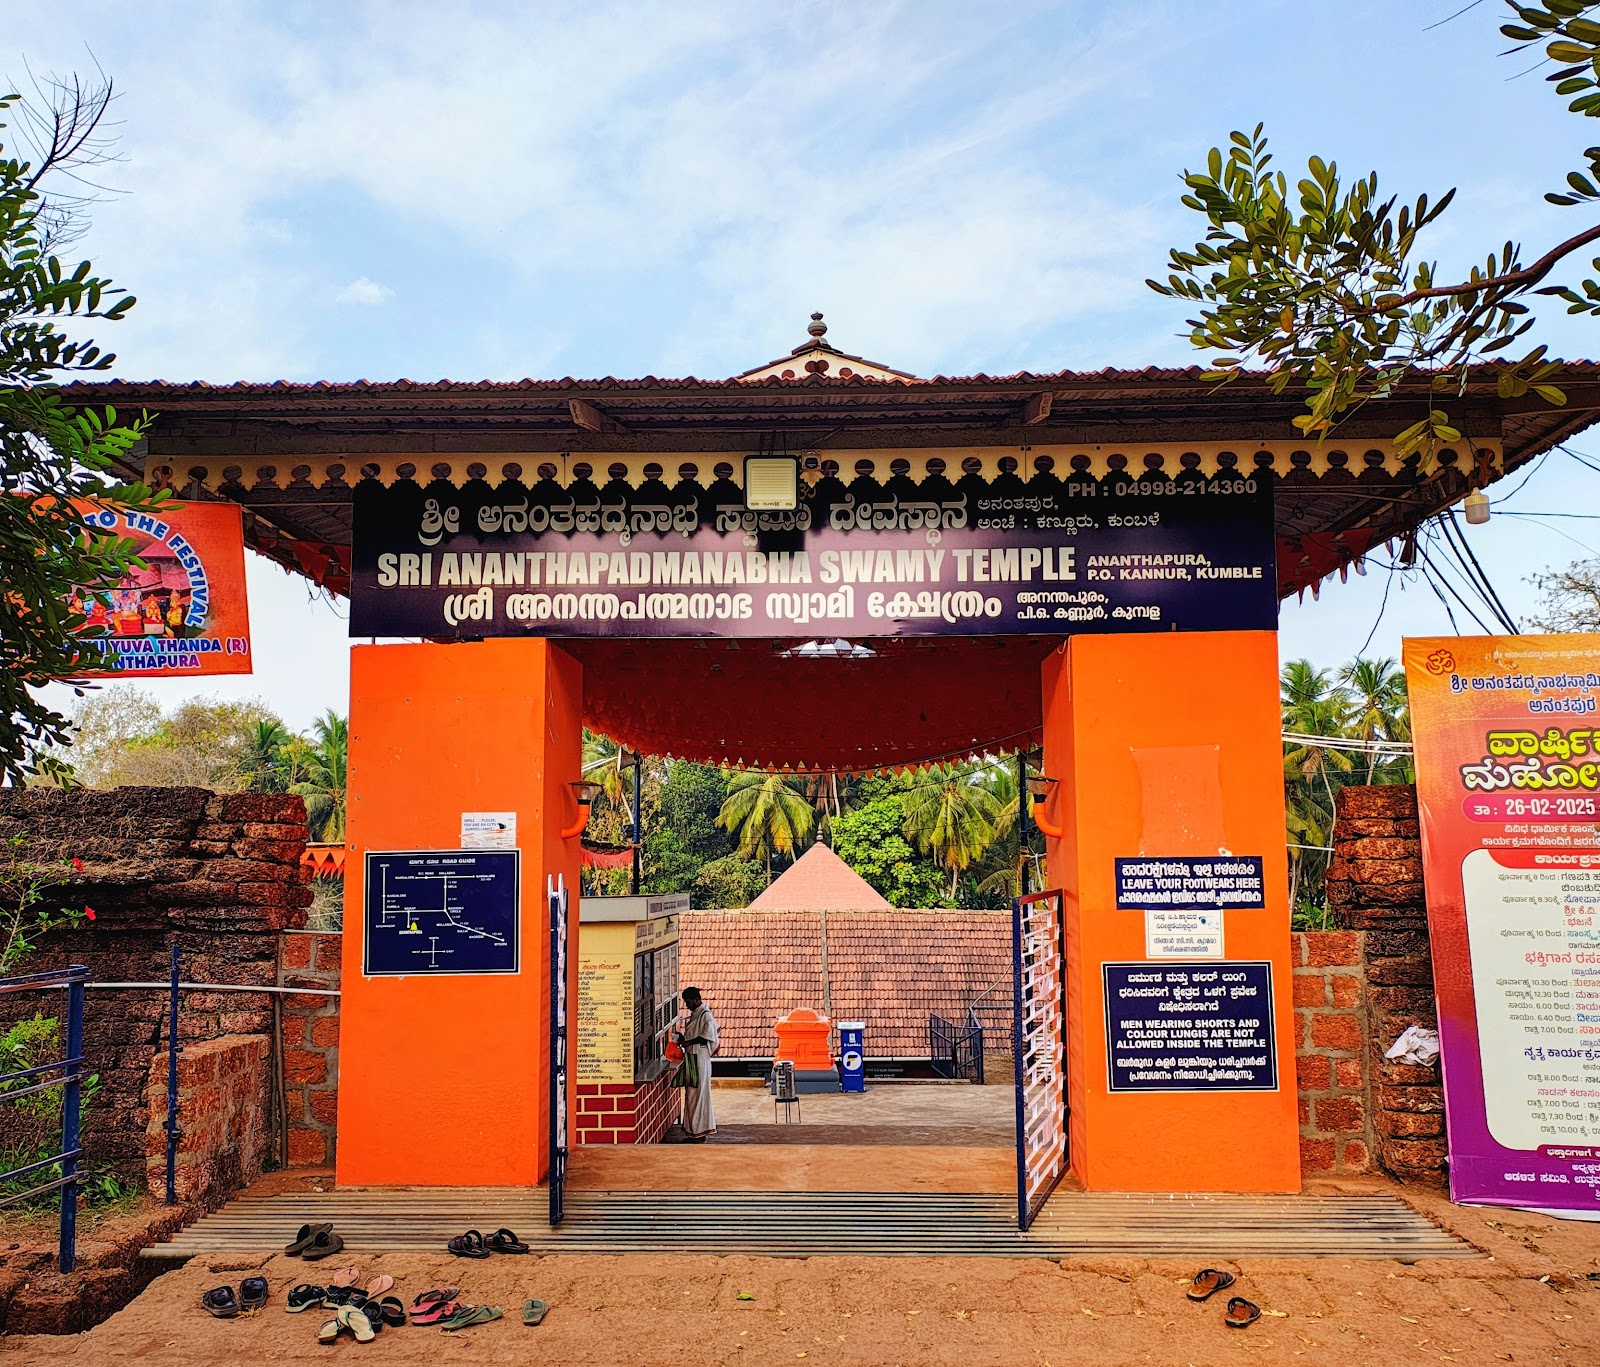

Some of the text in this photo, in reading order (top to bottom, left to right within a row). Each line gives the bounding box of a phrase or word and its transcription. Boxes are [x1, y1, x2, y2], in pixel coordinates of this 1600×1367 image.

[1068, 483, 1097, 497] PH
[1115, 479, 1257, 497] 04998-214360
[977, 496, 1058, 512] ಅನಂತಪುರ,
[418, 498, 460, 546] ಶ್ರೀ
[478, 495, 698, 547] ಅನಂತಪದ್ಮನಾಭ
[829, 492, 968, 548] ದೇವಸ್ಥಾನ
[977, 515, 1015, 530] ಅಂಚೆ
[1107, 512, 1160, 528] ಕುಂಬಳೆ
[377, 547, 1076, 587] SRI ANANTHAPADMANABHA SWAMY TEMPLE
[1087, 554, 1211, 567] ANANTHAPURA,
[84, 511, 208, 627] TO THE FESTIVAL
[1087, 567, 1262, 582] P.O. KANNUR, KUMBLE
[443, 585, 1002, 626] ശ്രീ അനന്തപത്മനാഭ സ്വാമി ക്ഷേത്രം
[1017, 591, 1109, 605] അനന്തപുരം,
[1112, 605, 1160, 621] കുമ്പള
[111, 640, 153, 653] YUVA
[158, 639, 221, 652] THANDA
[226, 638, 248, 655] (R)
[1451, 674, 1468, 693] ಶ್ರೀ
[1529, 697, 1596, 713] ಅನಂತಪುರ
[1506, 798, 1595, 815] 26-02-2025
[1122, 878, 1260, 889] LEAVE YOUR FOOTWEARS HERE
[1166, 972, 1189, 985] ಮತ್ತು
[1120, 1019, 1260, 1029] MEN WEARING SHORTS AND
[1126, 1029, 1255, 1039] COLOUR LUNGIS ARE NOT
[1116, 1039, 1266, 1049] ALLOWED INSIDE THE TEMPLE
